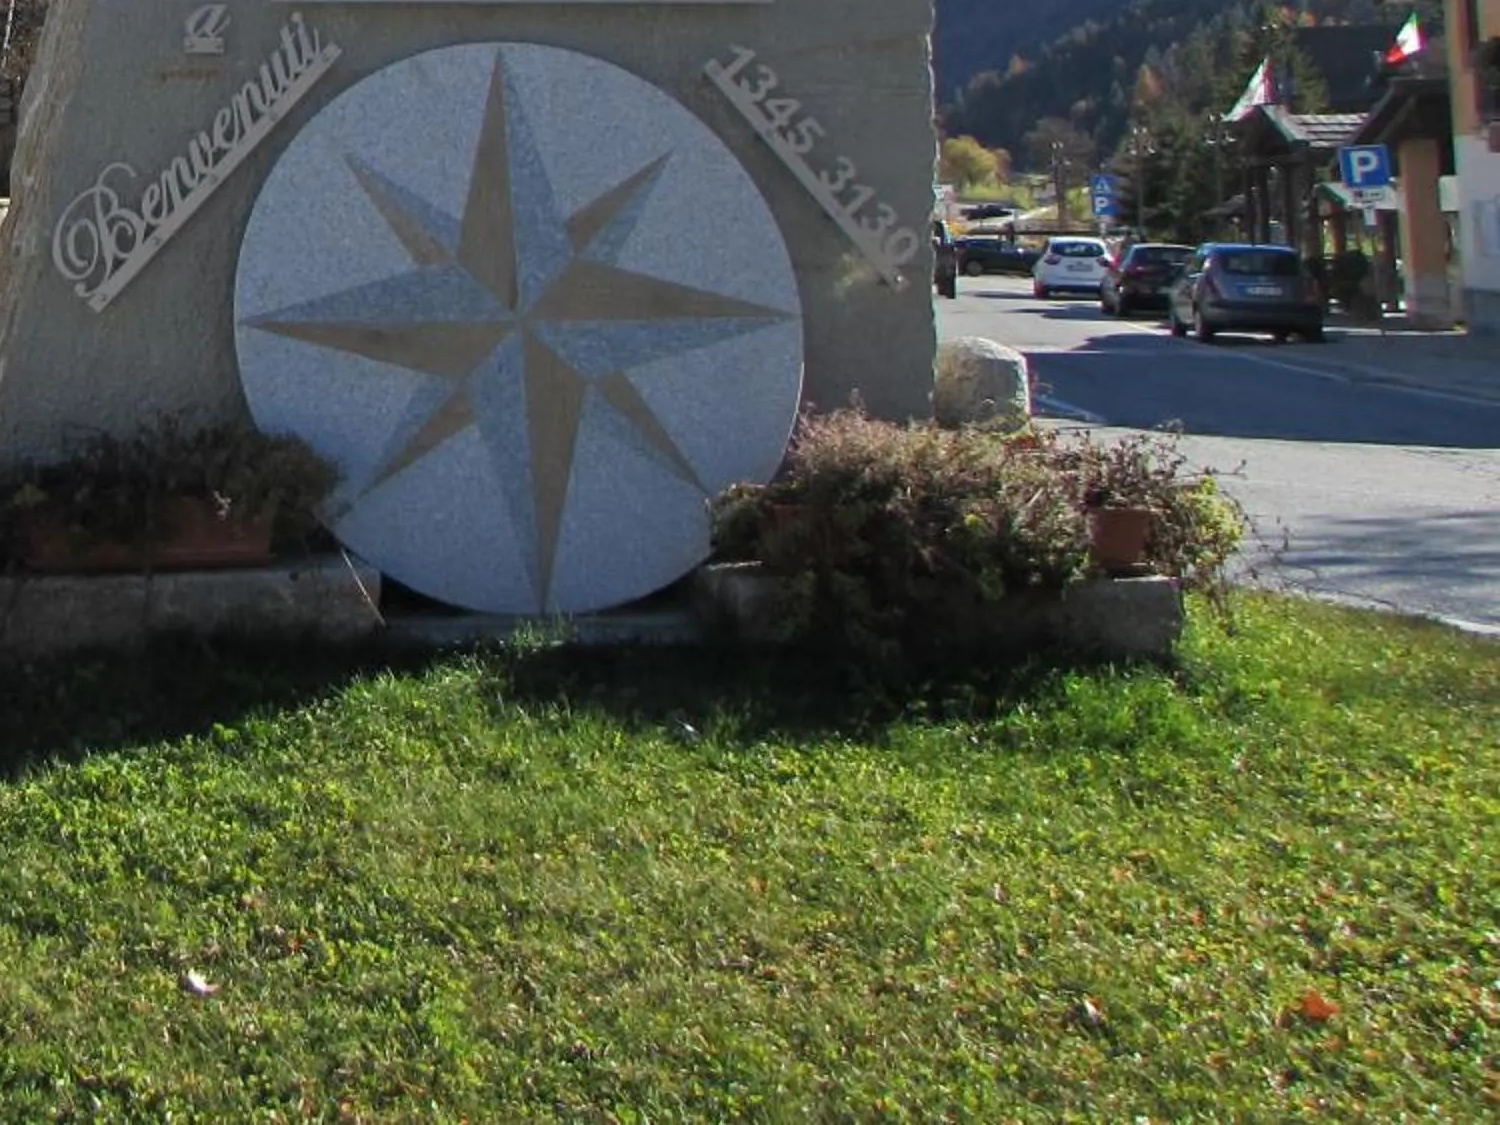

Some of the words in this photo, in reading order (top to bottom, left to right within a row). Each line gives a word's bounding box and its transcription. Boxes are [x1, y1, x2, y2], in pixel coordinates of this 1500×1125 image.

[184, 3, 232, 39] a
[52, 11, 324, 300] Benvenuti
[719, 42, 827, 155] 1345
[819, 155, 919, 266] 3130
[1349, 150, 1378, 184] P
[1095, 196, 1109, 213] P
